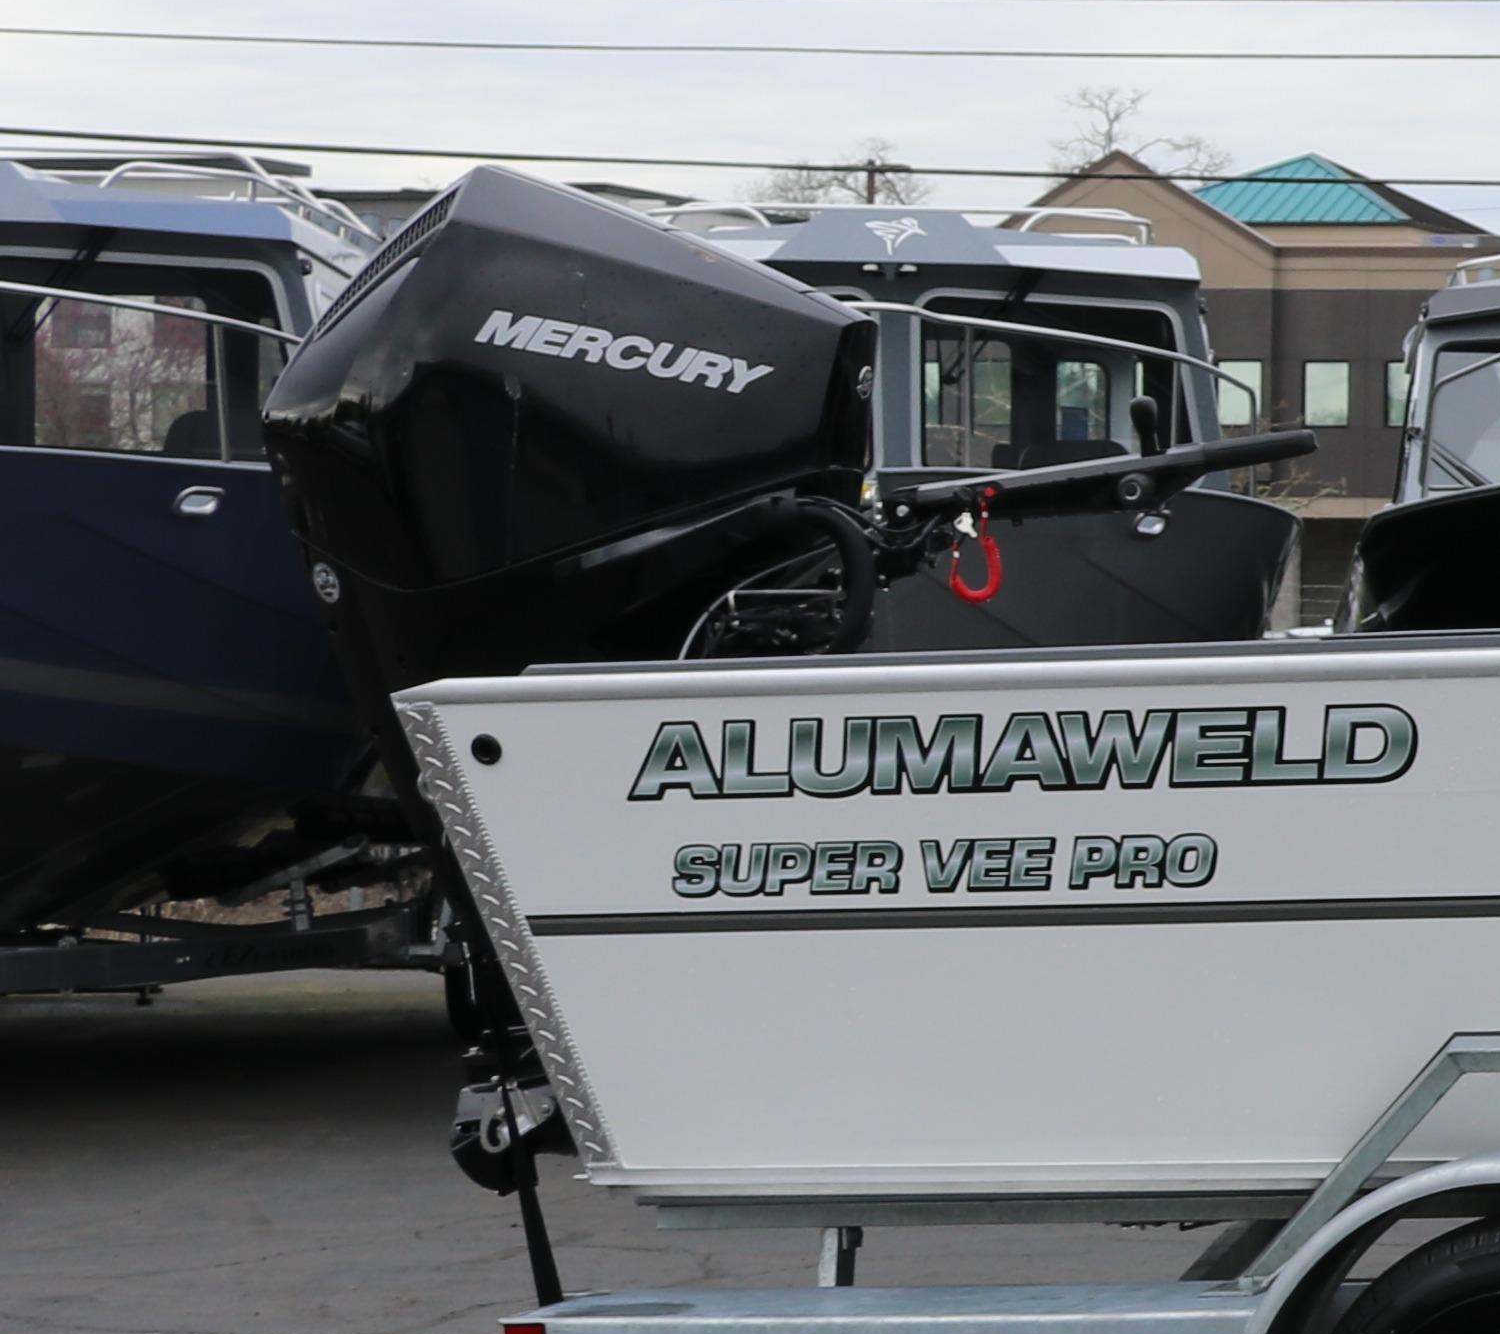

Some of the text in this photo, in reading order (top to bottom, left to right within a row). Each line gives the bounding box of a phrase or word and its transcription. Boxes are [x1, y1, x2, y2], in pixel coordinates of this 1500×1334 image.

[475, 310, 774, 395] MERCURY
[627, 703, 1418, 801] ALUMAWELD
[672, 833, 1217, 898] SUPER VEE PRO
